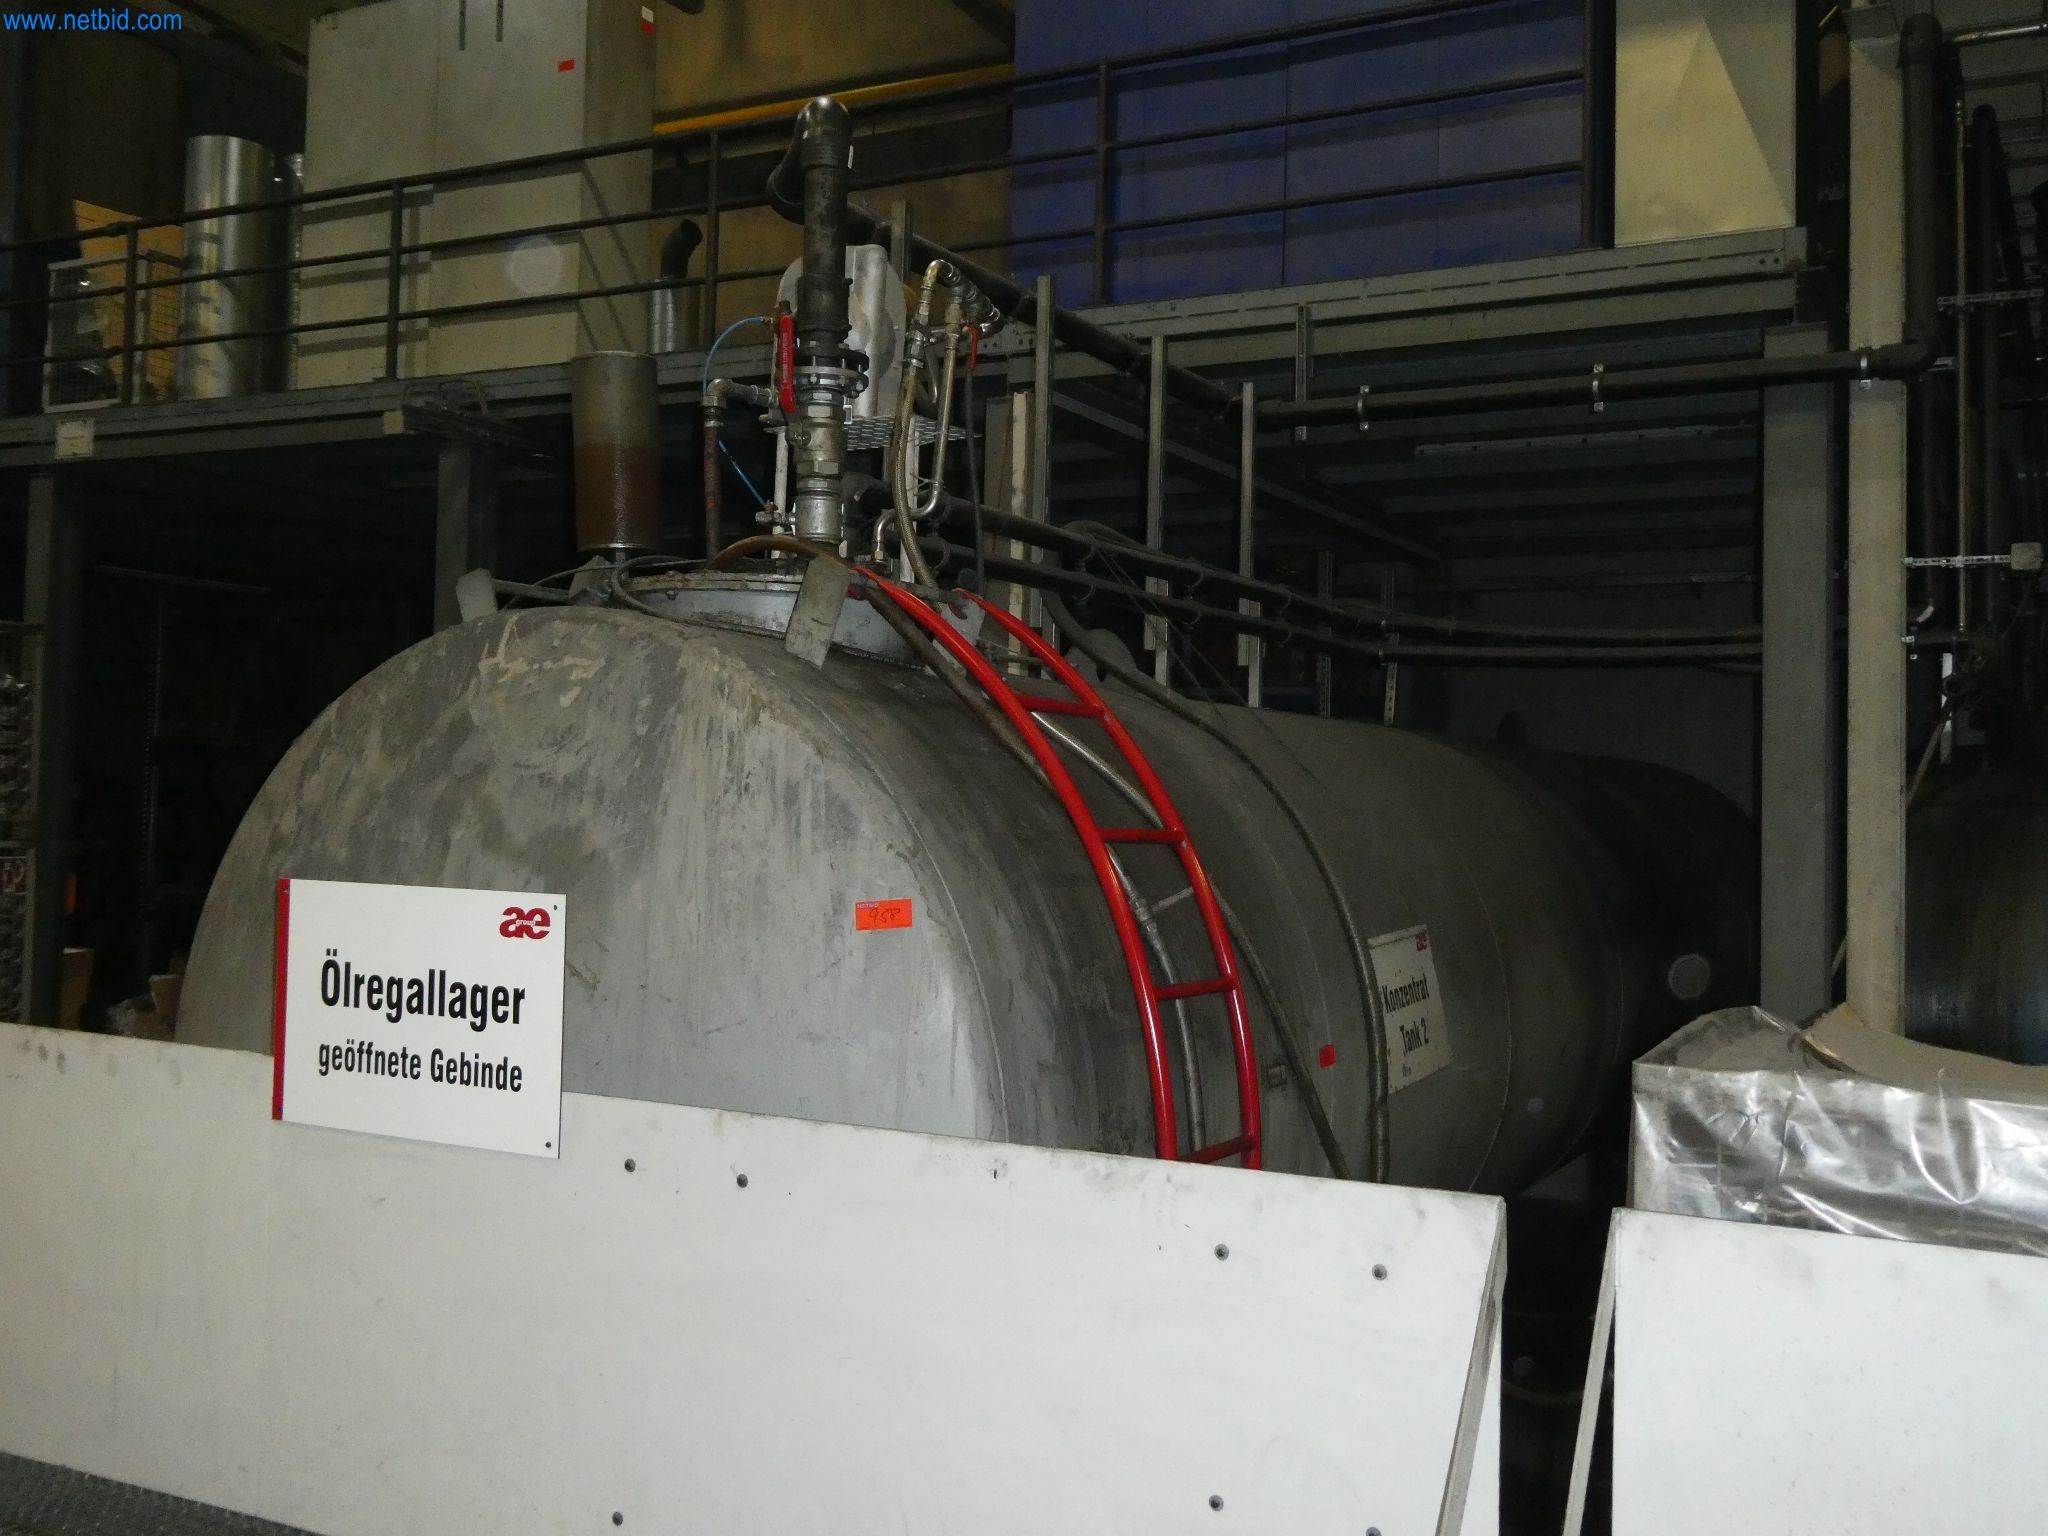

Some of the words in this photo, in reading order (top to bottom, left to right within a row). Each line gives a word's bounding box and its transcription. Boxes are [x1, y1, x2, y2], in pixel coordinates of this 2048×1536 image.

[320, 948, 526, 1033] Ölregallager
[1381, 972, 1430, 1014] Konzentrat
[1400, 1020, 1423, 1054] Tank
[1420, 1016, 1430, 1045] 2
[318, 1038, 422, 1081] geöffnete
[430, 1047, 523, 1093] Gebinde
